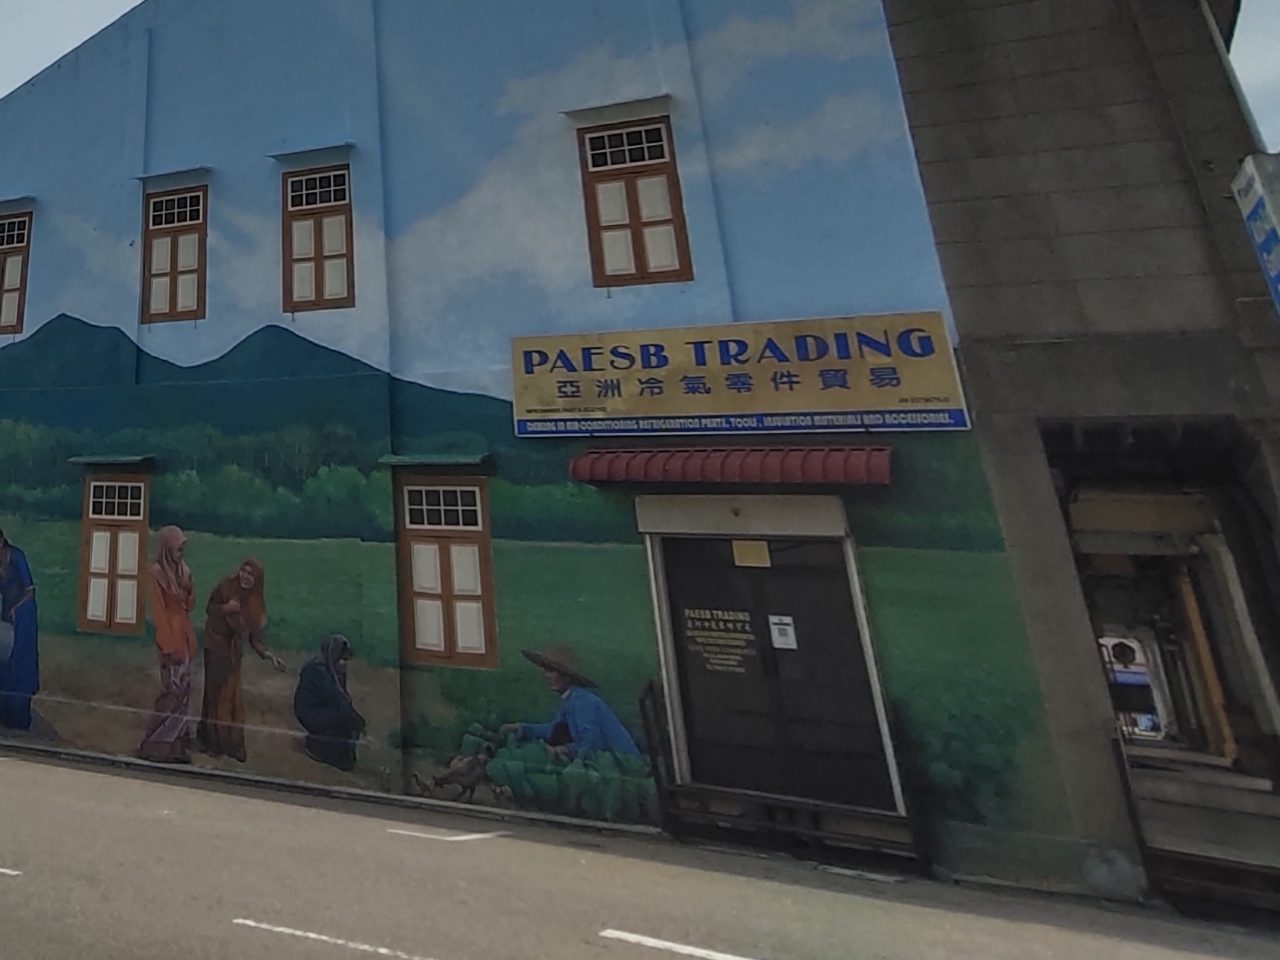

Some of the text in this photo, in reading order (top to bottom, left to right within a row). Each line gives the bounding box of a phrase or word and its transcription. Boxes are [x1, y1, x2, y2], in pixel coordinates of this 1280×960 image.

[522, 327, 936, 375] PAESB TRADING
[556, 367, 901, 399] 亞洲冷氣零件貿易
